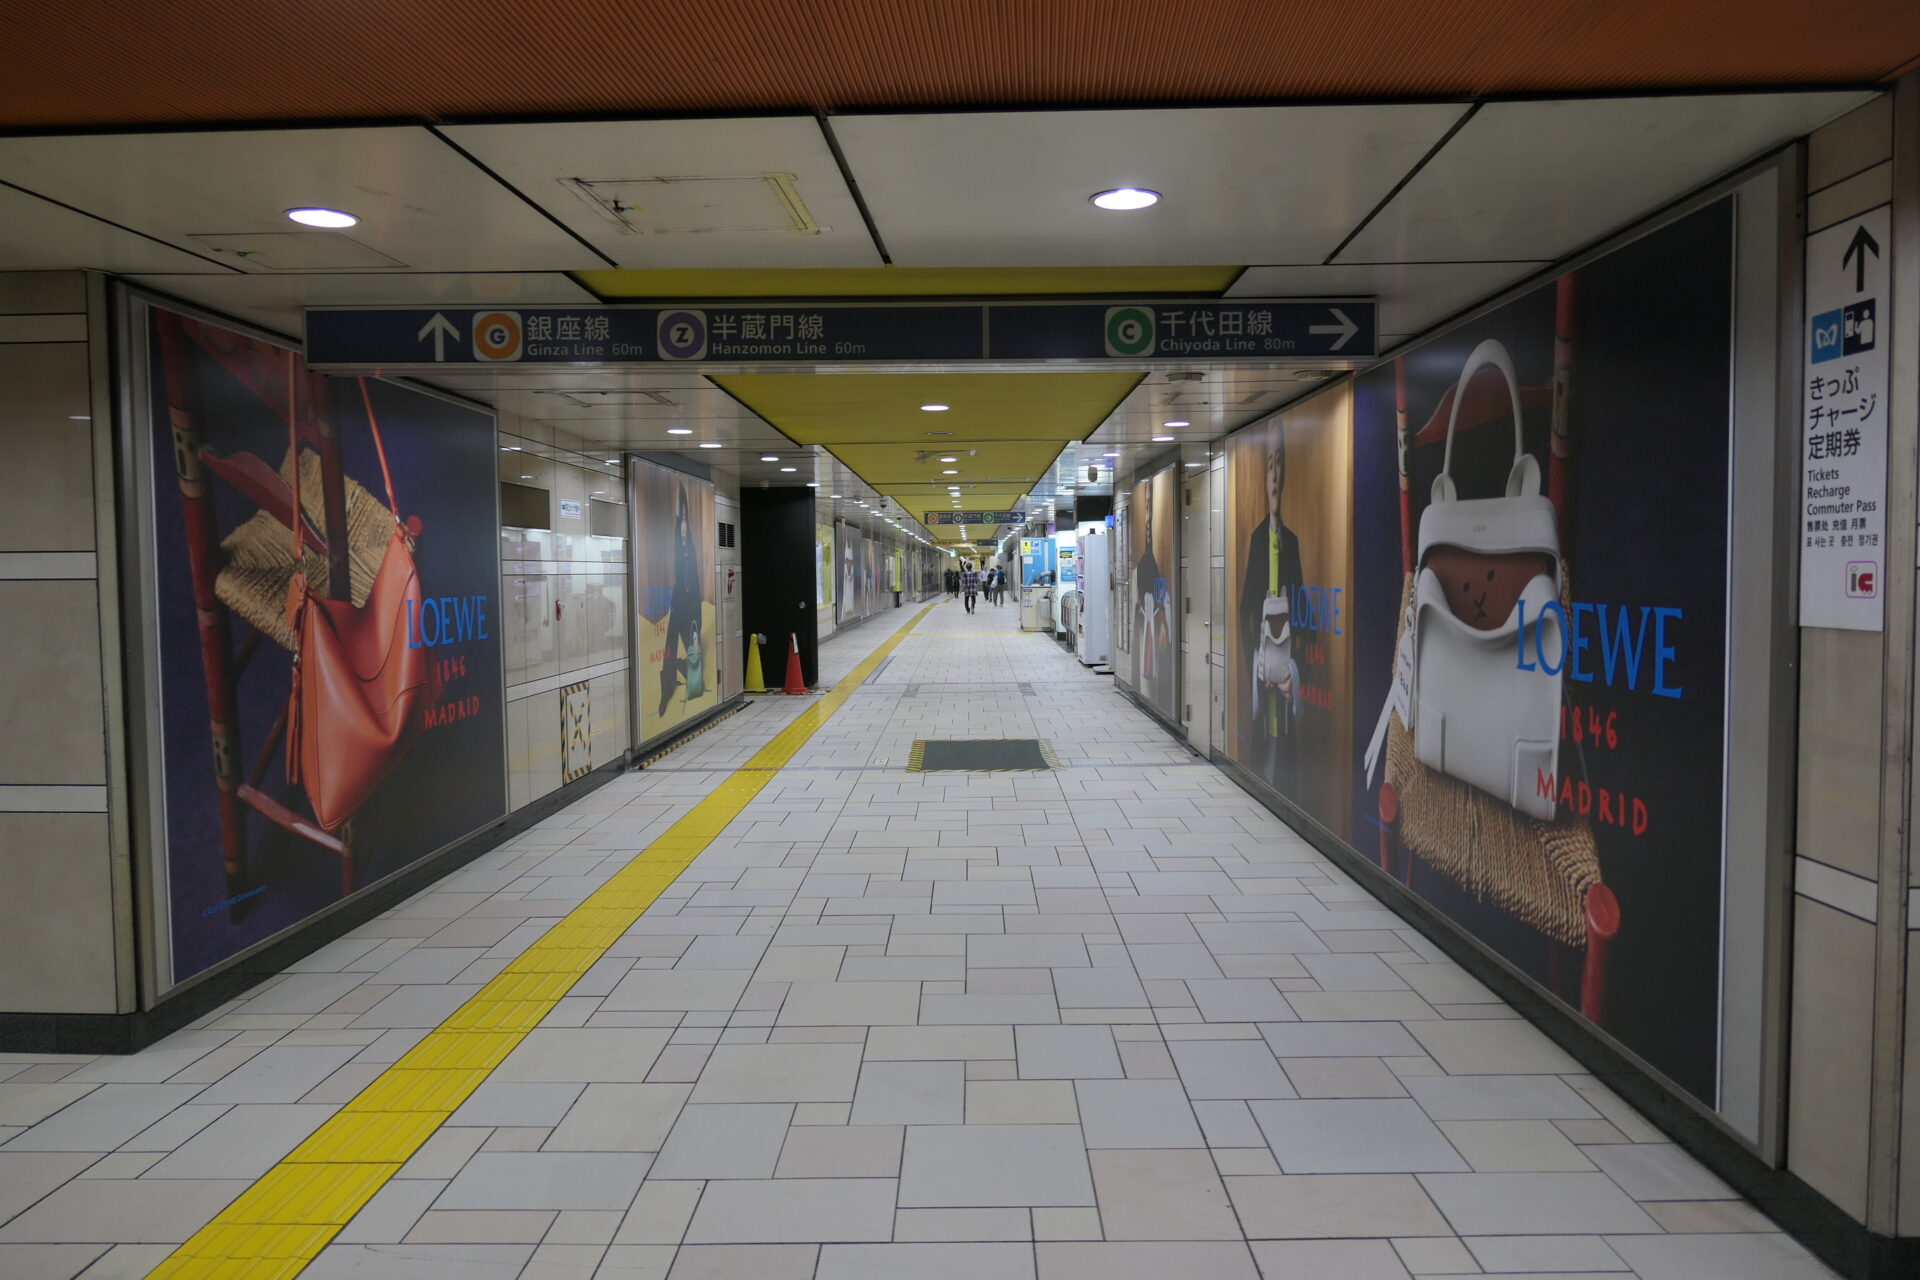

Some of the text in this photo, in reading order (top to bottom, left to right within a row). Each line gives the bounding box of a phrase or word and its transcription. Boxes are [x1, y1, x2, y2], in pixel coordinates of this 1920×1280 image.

[527, 316, 610, 341] 銀座線
[675, 327, 689, 343] Z
[712, 314, 824, 340] 半蔵門線
[1122, 323, 1135, 340] C
[1160, 310, 1273, 336] 千代田線
[490, 328, 506, 345] G
[527, 343, 643, 356] Ginza Line 60m
[712, 341, 866, 355] Hanzomon Line 60m
[1160, 338, 1295, 354] Chiyoda Line 80m
[1810, 366, 1859, 401] きっぷ
[1810, 393, 1876, 431] チャージ
[1808, 428, 1861, 460] 定期券
[1807, 468, 1839, 482] Tickets
[1807, 485, 1850, 500] Recharge
[1807, 499, 1877, 516] Commuter Pass
[406, 595, 489, 649] LOEWE
[1290, 584, 1344, 635] LOEWE
[1516, 599, 1683, 699] LOEWE
[436, 655, 467, 682] 1846
[424, 695, 480, 731] MADRID
[1560, 704, 1617, 749] 1846
[1537, 766, 1648, 836] MADRID
